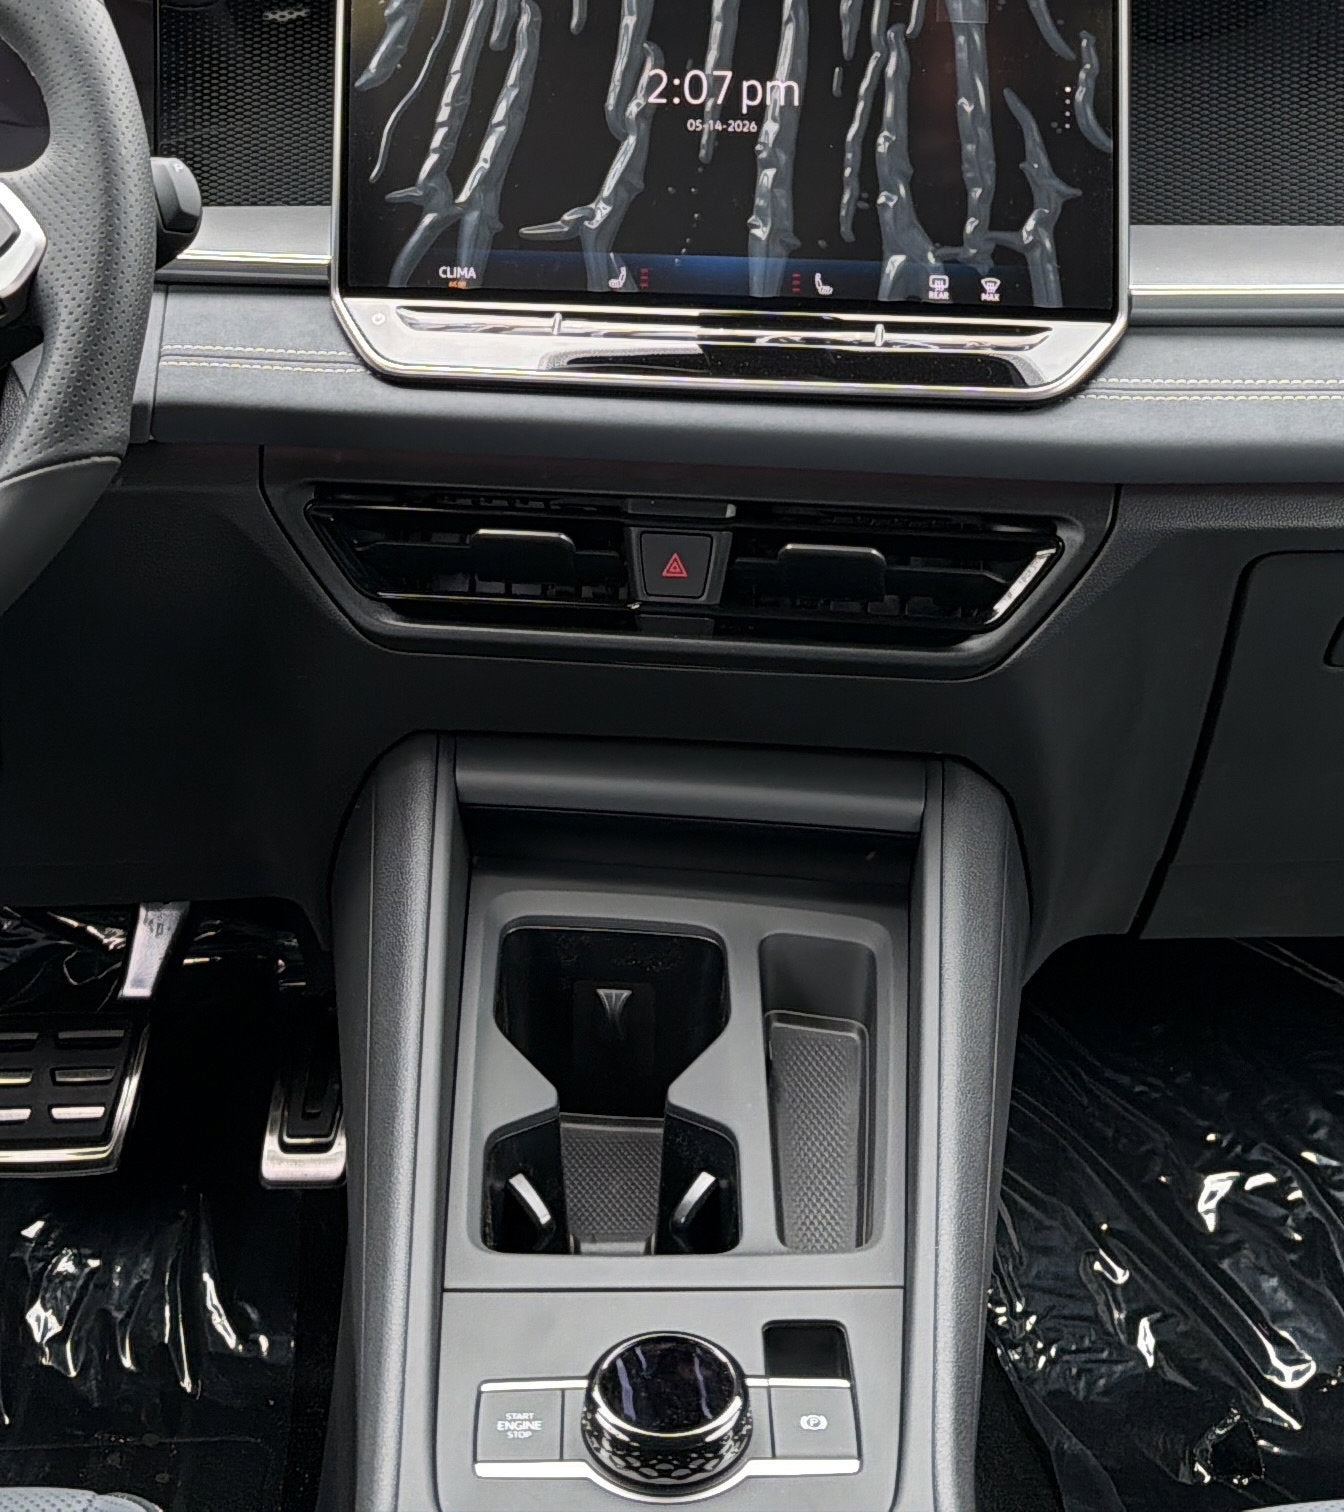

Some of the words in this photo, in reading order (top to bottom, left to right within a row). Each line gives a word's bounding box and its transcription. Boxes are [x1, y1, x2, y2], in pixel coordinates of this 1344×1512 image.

[647, 68, 733, 105] 2:07
[742, 79, 799, 114] pm
[687, 119, 758, 132] 05-14-2026
[438, 266, 476, 279] CLIMA
[929, 291, 950, 300] REAR
[981, 293, 1000, 301] MAX
[497, 1421, 543, 1430] ENGINE
[506, 1431, 533, 1439] STOP
